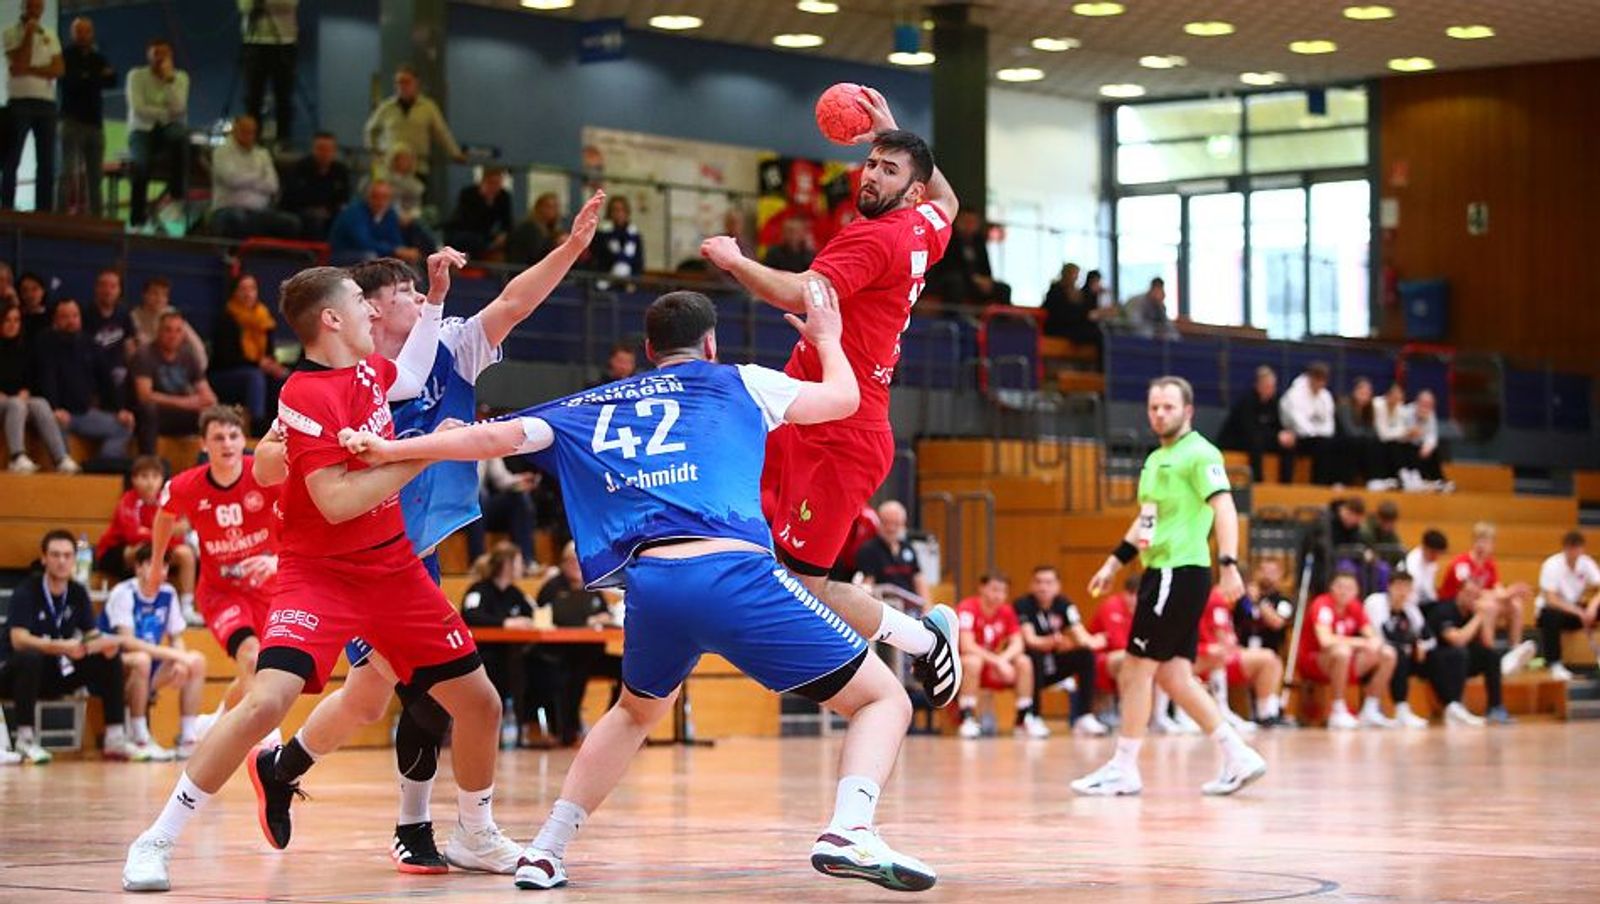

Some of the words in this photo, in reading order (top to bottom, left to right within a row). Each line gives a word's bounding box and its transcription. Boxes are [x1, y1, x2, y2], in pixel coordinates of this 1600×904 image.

[591, 397, 687, 460] 42
[216, 502, 244, 528] 60
[446, 629, 465, 649] 11
